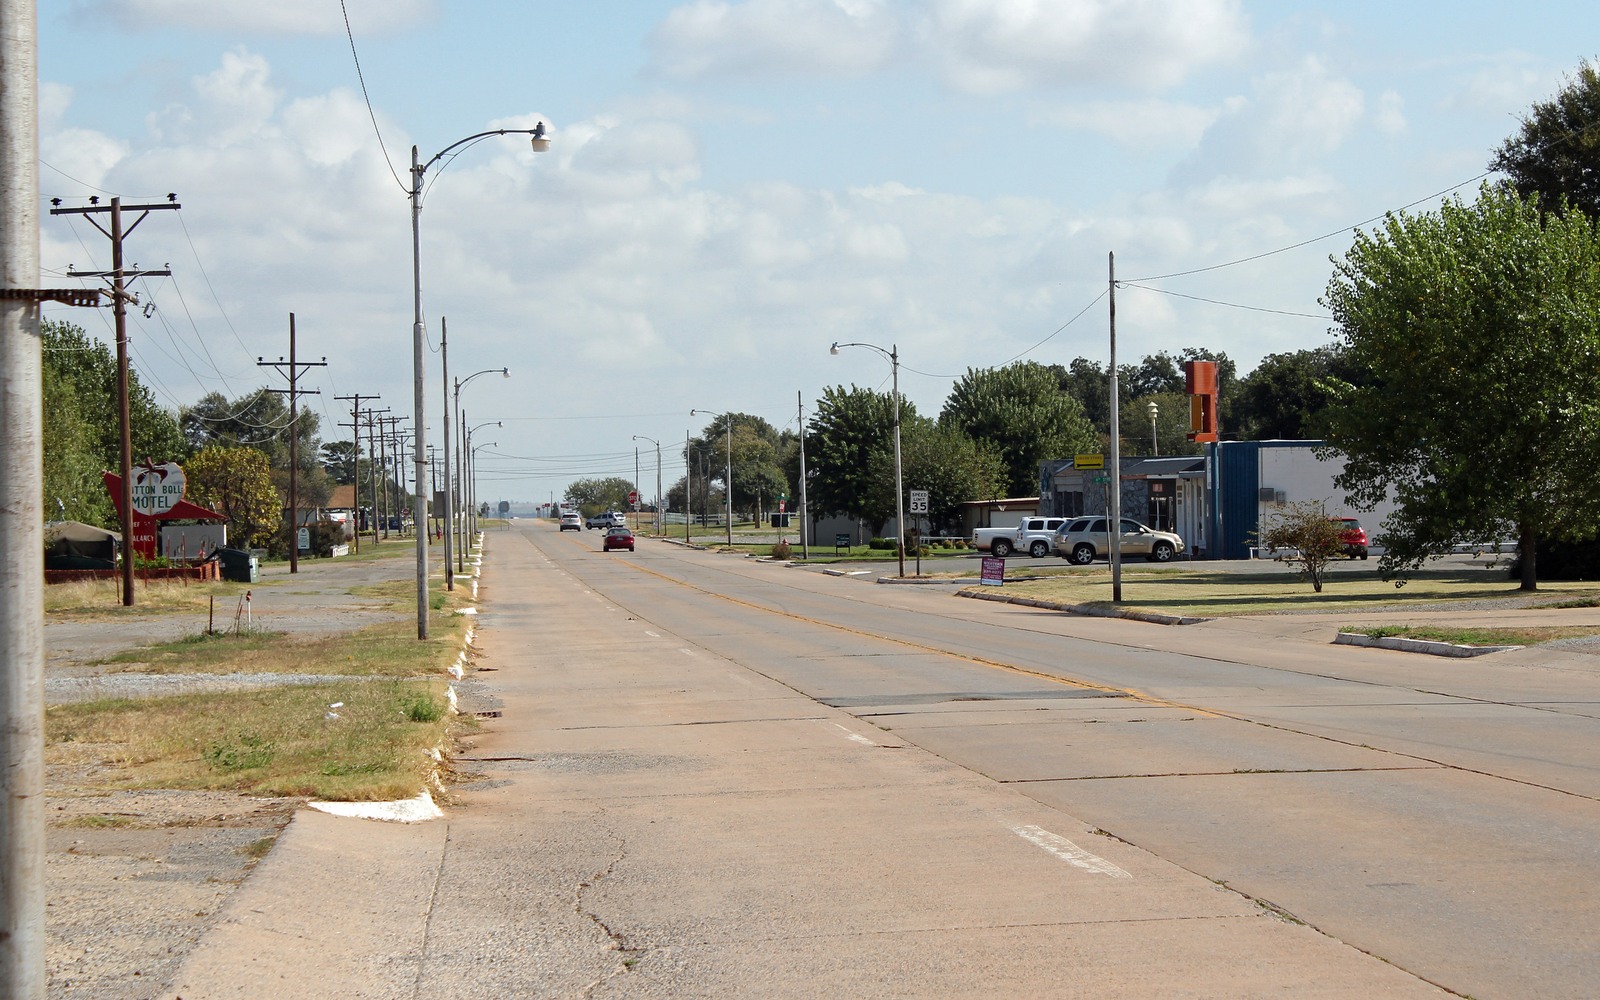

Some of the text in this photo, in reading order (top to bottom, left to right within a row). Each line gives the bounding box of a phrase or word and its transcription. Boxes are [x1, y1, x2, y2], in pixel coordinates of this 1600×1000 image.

[132, 486, 182, 494] TTON BOLL
[132, 496, 172, 508] MOTEL
[912, 502, 926, 510] 35
